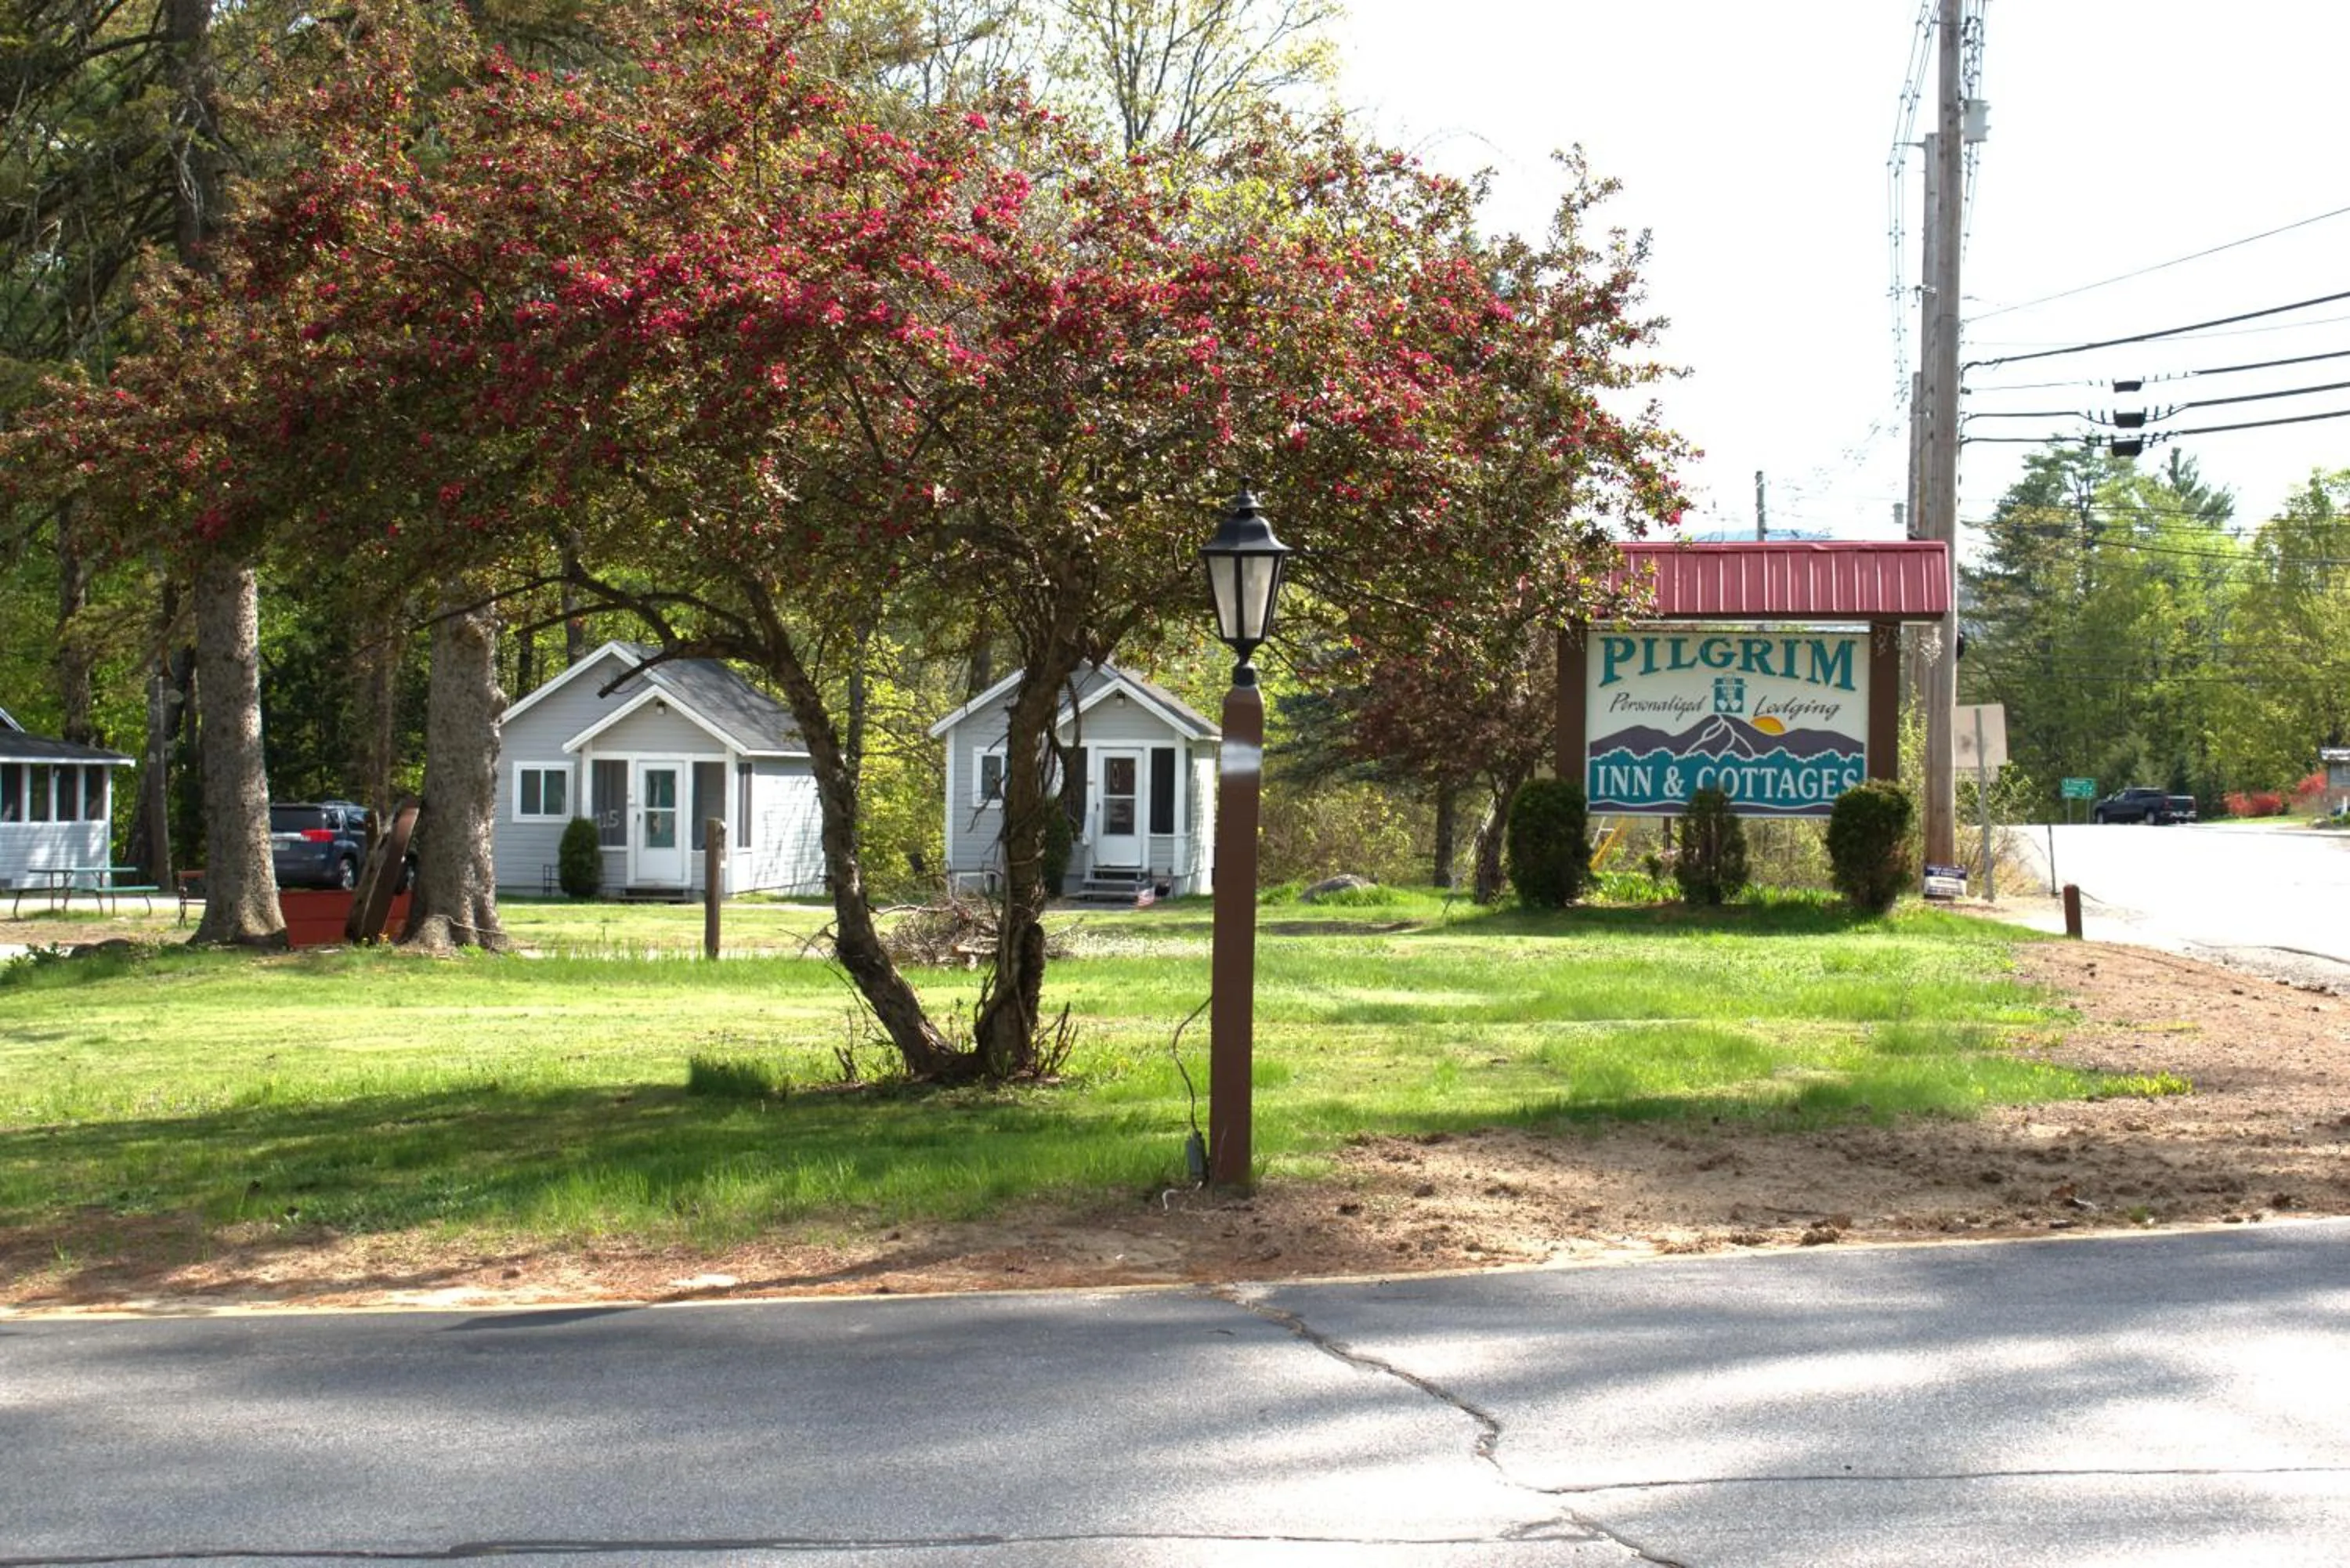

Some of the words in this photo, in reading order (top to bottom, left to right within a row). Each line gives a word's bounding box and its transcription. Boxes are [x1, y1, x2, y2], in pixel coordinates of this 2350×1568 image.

[1599, 637, 1856, 692] PILGRIM
[1609, 692, 1707, 721] Personalized
[1753, 695, 1841, 721] Lodging
[1597, 765, 1653, 797] INN
[1663, 766, 1685, 797] &
